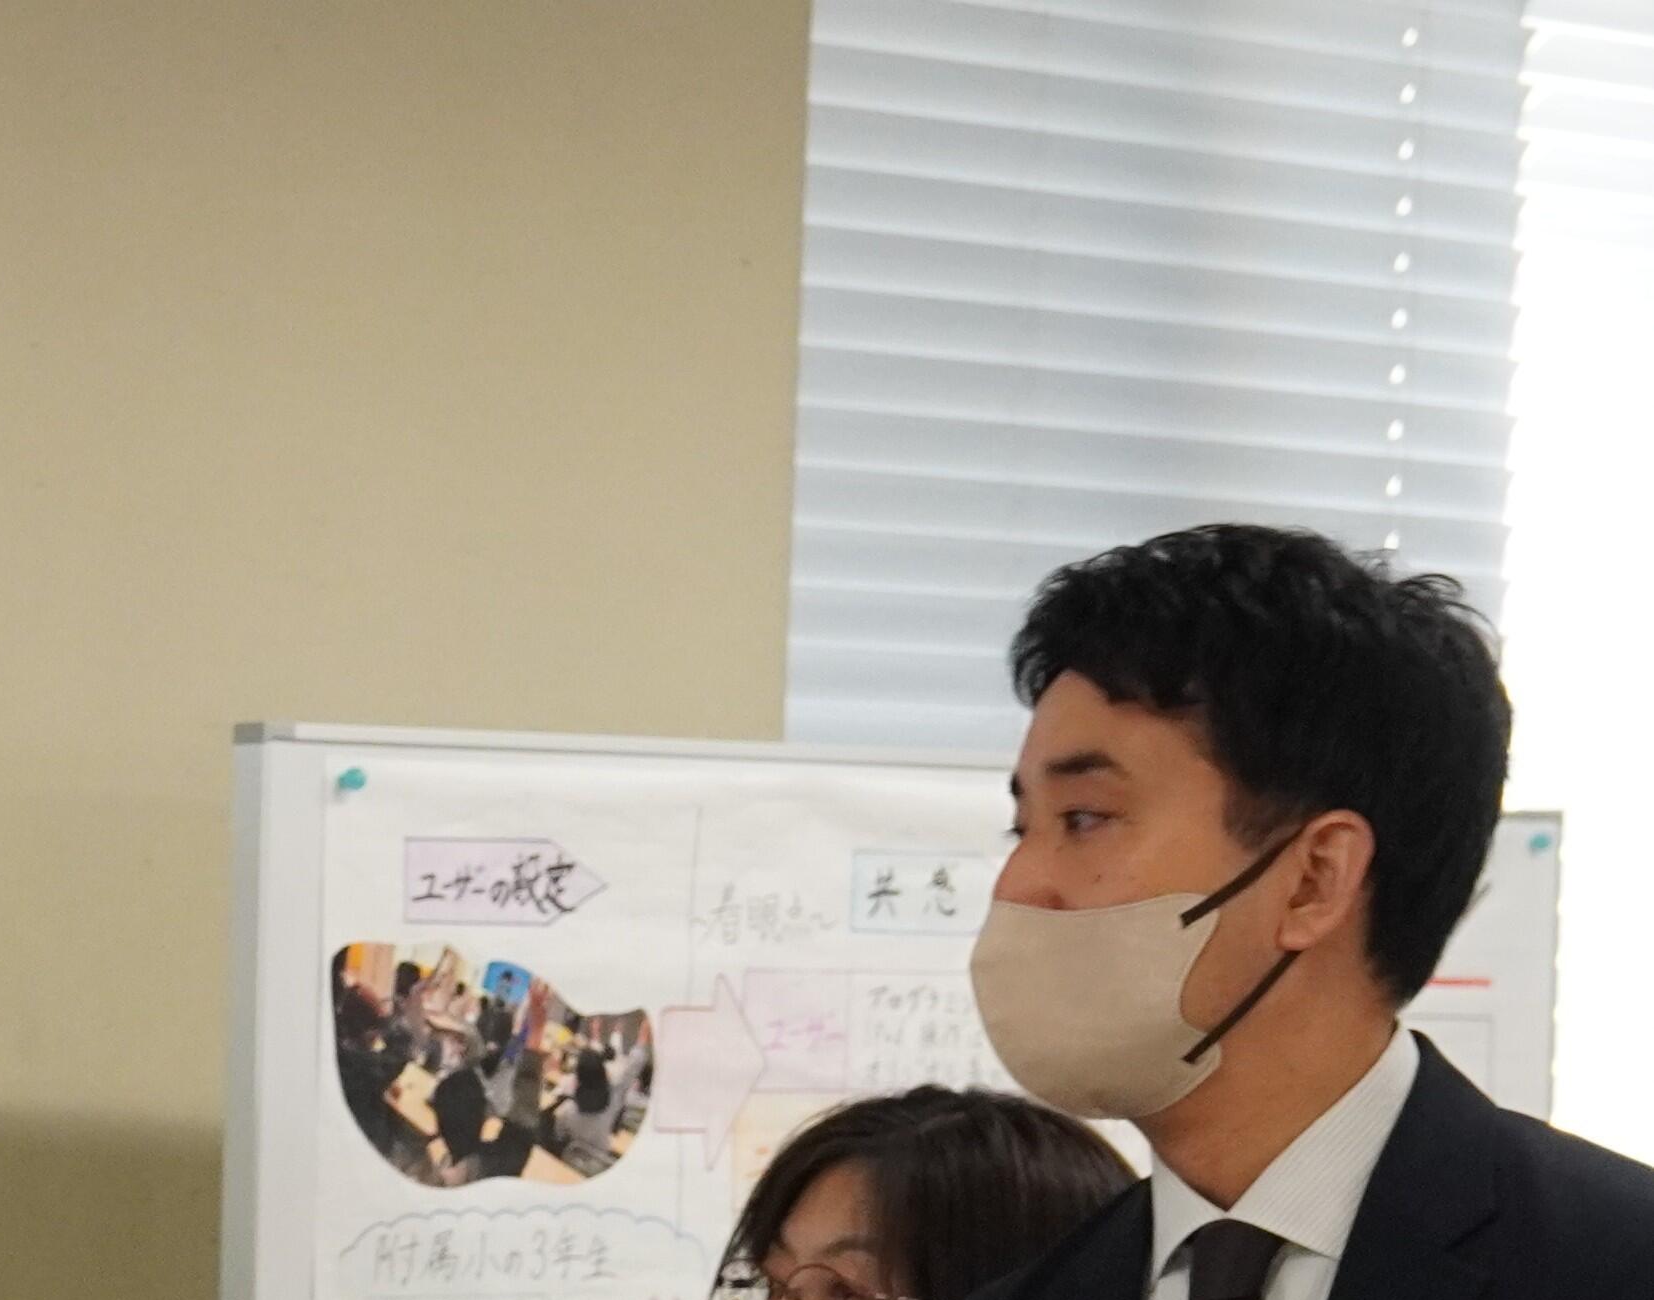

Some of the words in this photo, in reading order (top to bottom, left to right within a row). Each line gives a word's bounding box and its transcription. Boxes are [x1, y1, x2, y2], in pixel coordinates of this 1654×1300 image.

[411, 854, 576, 914] ユーザーの設定
[374, 1228, 620, 1286] 附属小の3年生
